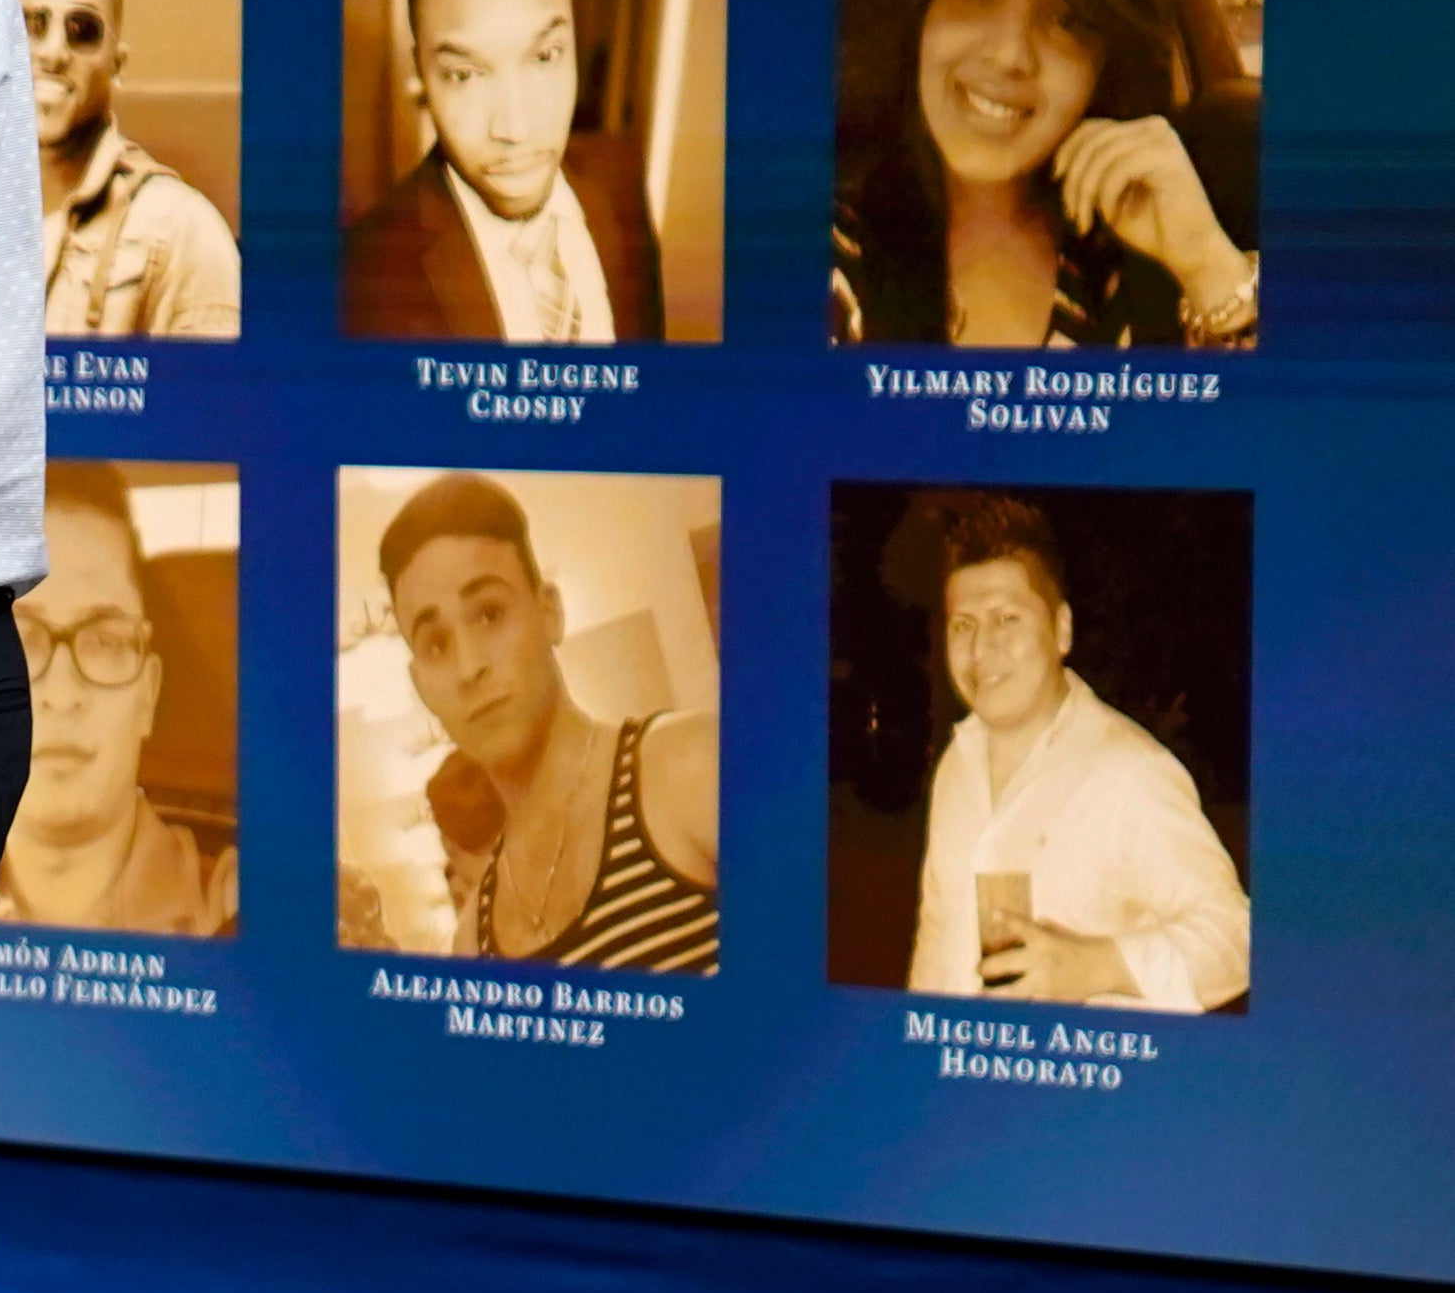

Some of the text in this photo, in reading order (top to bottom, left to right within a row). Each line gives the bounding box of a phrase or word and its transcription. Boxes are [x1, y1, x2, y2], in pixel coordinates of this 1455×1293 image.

[74, 351, 150, 382] EVAN
[416, 355, 640, 393] TEVIN EUGENE
[867, 362, 1221, 401] YILMARY RODRÍGUEZ
[45, 385, 146, 414] LINSON
[468, 388, 586, 425] CROSBY
[967, 399, 1112, 434] SOLIVAN
[59, 943, 166, 980] ADRIAN
[52, 971, 218, 1016] FERNÁNDEZ
[371, 967, 687, 1024] ALEJANDRO BARRIOS
[444, 1004, 607, 1050] MARTINEZ
[903, 1009, 1160, 1061] MIGUEL ANGEL
[939, 1045, 1123, 1089] HONORATO
